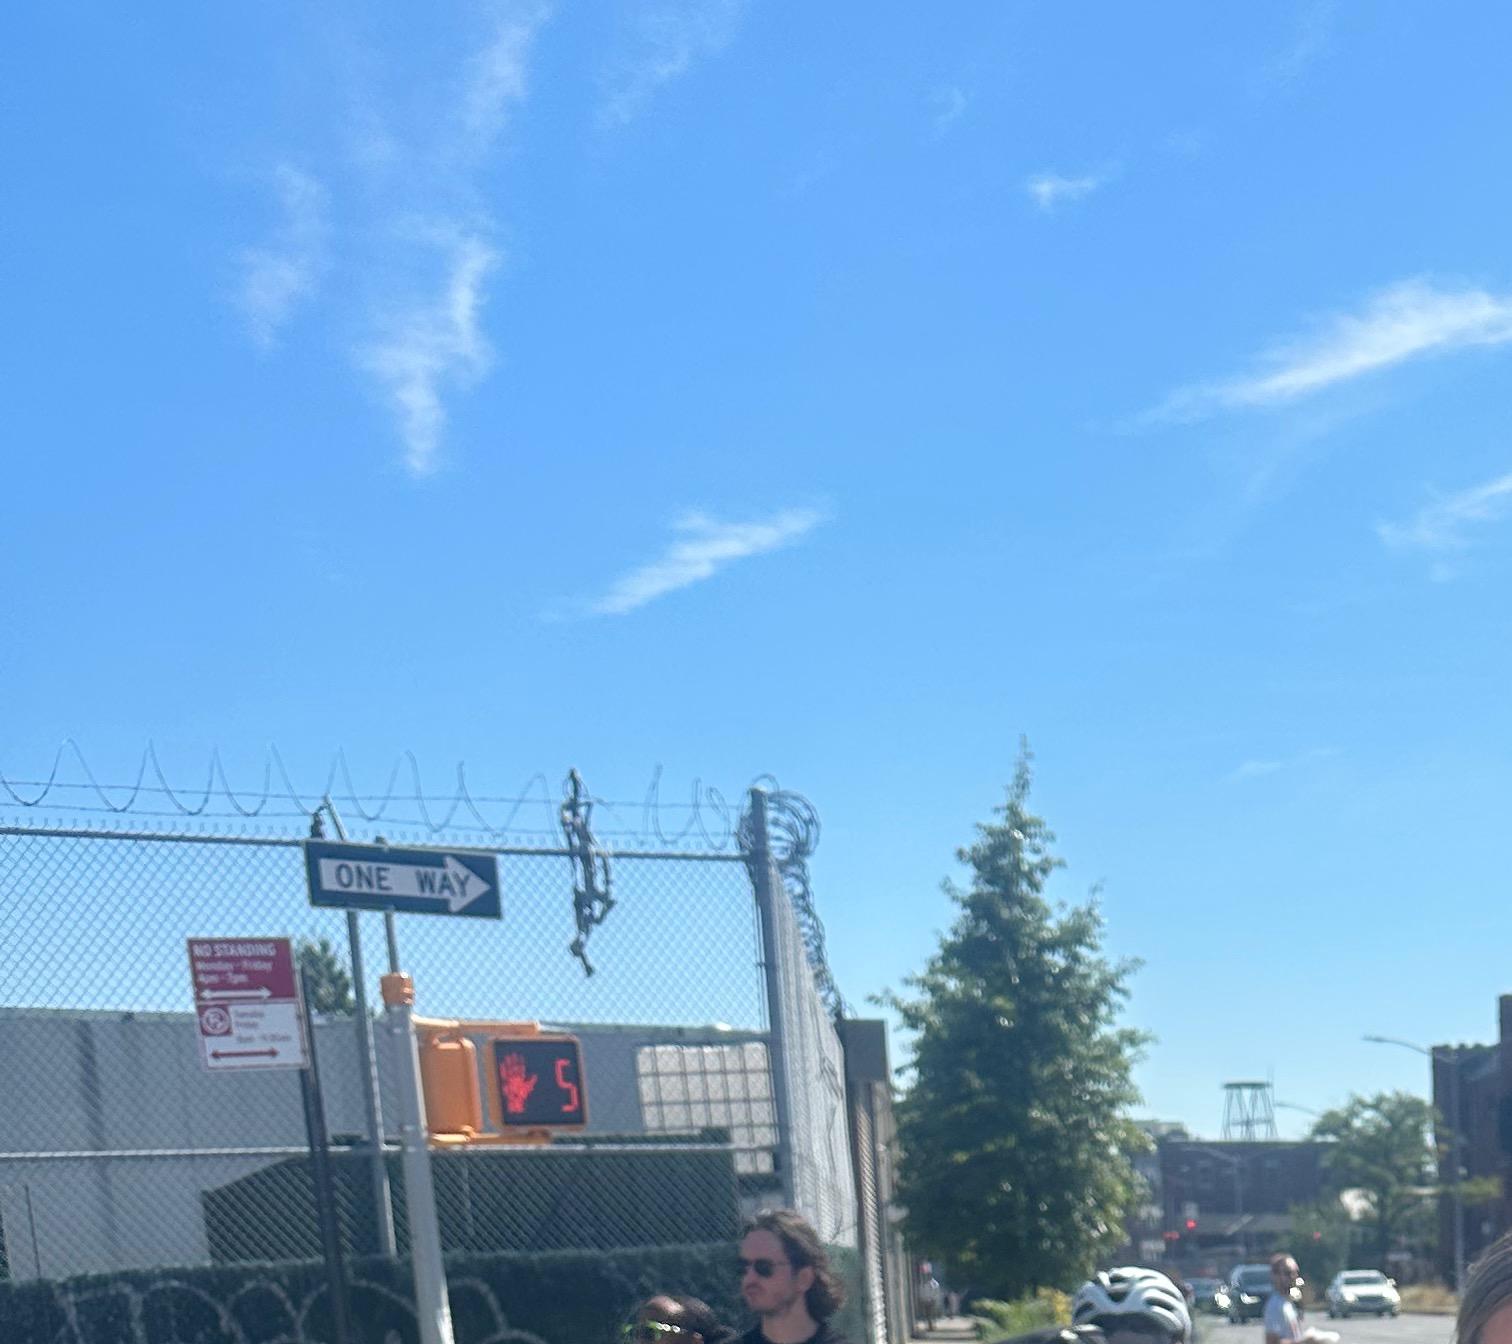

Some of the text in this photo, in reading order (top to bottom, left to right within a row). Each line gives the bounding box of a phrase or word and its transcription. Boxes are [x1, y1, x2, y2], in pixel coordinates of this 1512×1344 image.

[335, 863, 470, 898] ONE WAY
[193, 943, 277, 957] NO STANDING
[555, 1058, 577, 1112] 5
